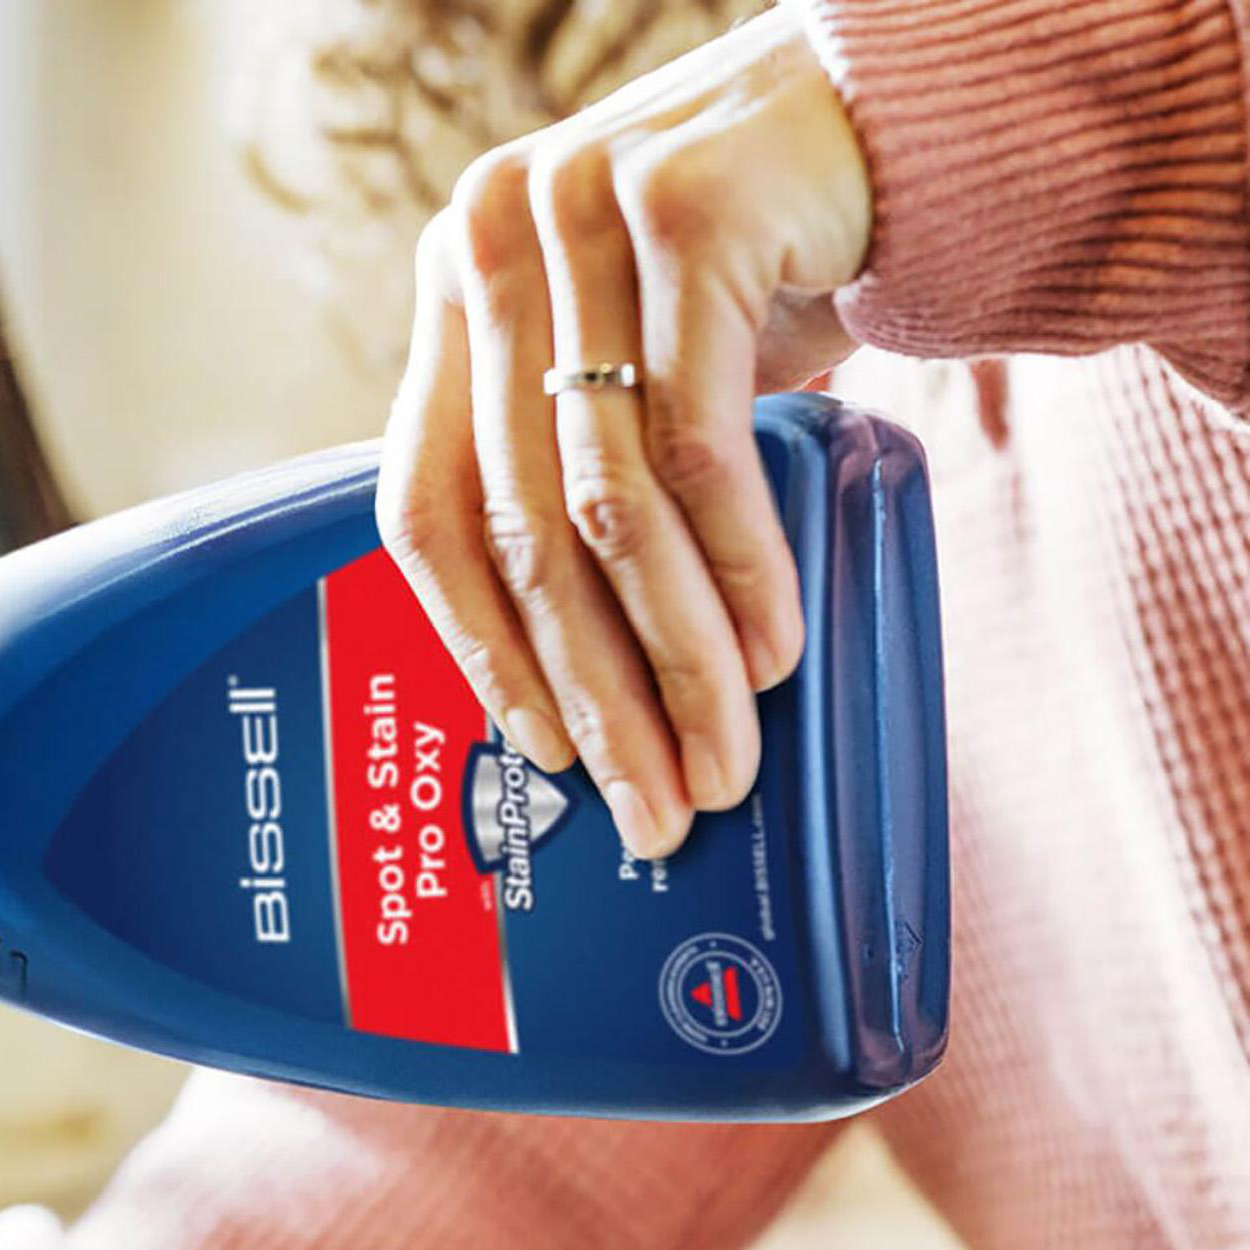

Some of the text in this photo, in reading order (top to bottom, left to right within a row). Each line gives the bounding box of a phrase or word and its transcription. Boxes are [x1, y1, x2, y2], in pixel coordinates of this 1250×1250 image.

[363, 674, 409, 945] Spot & Stain
[409, 722, 447, 898] Pro Oxy
